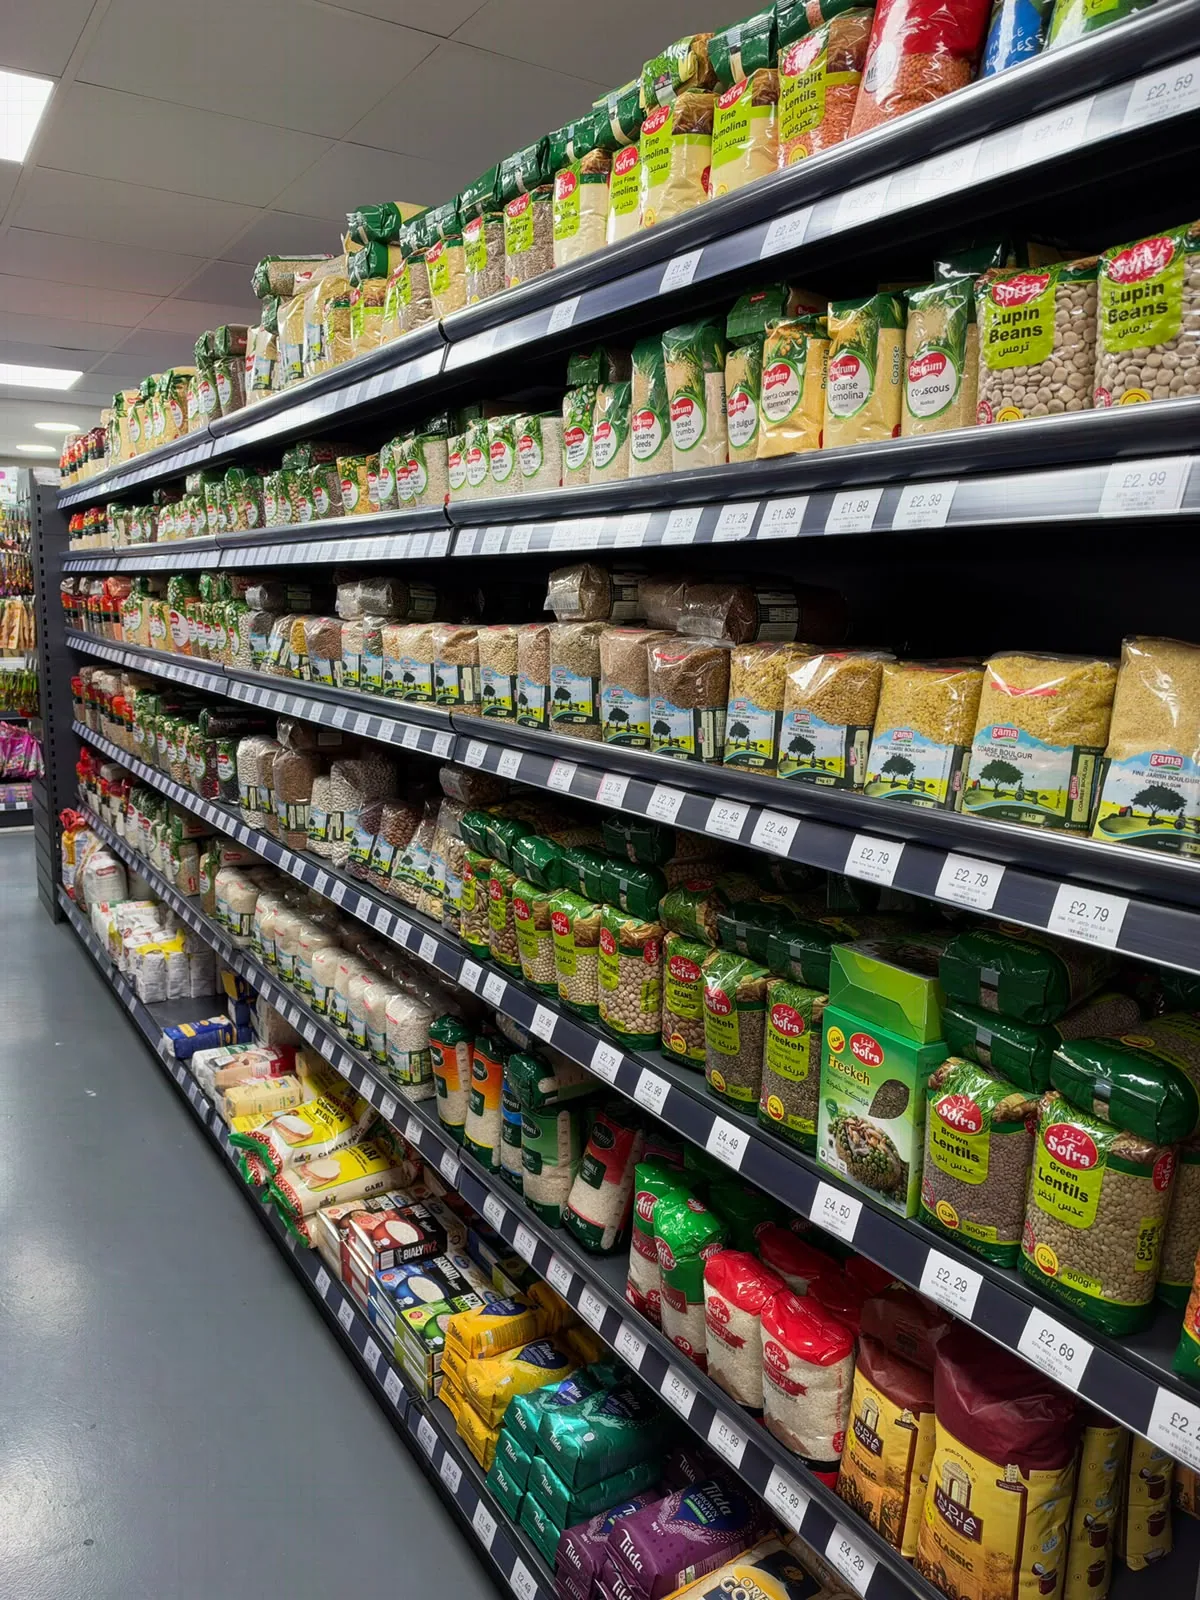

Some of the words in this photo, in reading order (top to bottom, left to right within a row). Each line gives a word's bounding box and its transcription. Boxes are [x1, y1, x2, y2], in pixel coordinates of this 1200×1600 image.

[797, 72, 822, 89] Split
[1146, 73, 1194, 101] £2.59
[719, 86, 743, 106] Sofra
[784, 89, 817, 112] Lentils
[643, 113, 666, 131] Sofra
[720, 110, 737, 124] Fine
[645, 137, 660, 148] Fine
[615, 156, 634, 170] Sofra
[624, 176, 636, 184] Fine
[996, 282, 1042, 301] Sofra
[1110, 282, 1165, 306] Lupin
[992, 306, 1040, 328] Lupin
[1108, 299, 1168, 325] Beans
[989, 324, 1043, 344] Beans
[820, 350, 830, 390] Polenta
[891, 345, 900, 385] Coarse
[778, 389, 799, 398] Coarse
[833, 381, 858, 392] Coarse
[634, 432, 655, 440] Sesame
[676, 426, 696, 436] Crumbs
[636, 440, 652, 448] Seeds
[1122, 471, 1166, 488] £2.99
[910, 493, 942, 508] £2.39
[725, 512, 748, 524] £1.29
[893, 730, 913, 739] gama
[992, 728, 1018, 738] gama
[1000, 748, 1033, 760] BOULGUR
[1150, 754, 1182, 766] gama
[1070, 776, 1079, 800] gama
[717, 808, 739, 822] £2.49
[765, 820, 788, 837] £2.49
[860, 848, 890, 864] £2.79
[954, 868, 989, 887] £2.79
[1068, 900, 1109, 922] £2.79
[670, 963, 696, 980] Sofra
[674, 990, 693, 1000] BEANS
[773, 1012, 800, 1034] Sofra
[769, 1030, 804, 1052] Freekeh
[599, 1048, 616, 1066] £2.79
[852, 1042, 880, 1064] Sofra
[828, 1054, 870, 1086] Freekeh
[644, 1078, 662, 1097] £2.99
[316, 1098, 346, 1122] CASSAVA
[938, 1102, 976, 1132] Sofra
[717, 1130, 738, 1150] £4.49
[941, 1126, 969, 1146] Brown
[932, 1131, 980, 1164] Lentils
[1047, 1136, 1090, 1167] Sofra
[950, 1161, 974, 1175] عدس
[1049, 1160, 1078, 1182] Green
[364, 1181, 384, 1192] GARI
[1038, 1166, 1090, 1204] Lentils
[824, 1197, 851, 1219] £4.50
[1057, 1202, 1084, 1218] عدس
[403, 1246, 424, 1260] BIAŁY
[1136, 1228, 1148, 1261] Green
[433, 1257, 460, 1280] BASMATI
[936, 1268, 968, 1292] £2.29
[624, 1334, 640, 1352] £2.19
[678, 1340, 690, 1351] 30
[1038, 1328, 1075, 1361] £2.69
[672, 1376, 690, 1400] £2.19
[516, 1408, 528, 1431] Tilda
[1170, 1412, 1200, 1441] £2.2
[550, 1433, 562, 1452] Tilda
[718, 1424, 740, 1448] £1.99
[854, 1426, 879, 1452] GATE
[856, 1420, 880, 1447] INDIA
[504, 1440, 518, 1463] Tilda
[679, 1454, 696, 1482] Tilda
[850, 1450, 878, 1481] CLASSIC
[496, 1469, 509, 1493] Tilda
[541, 1474, 553, 1496] Tilda
[695, 1491, 720, 1516] BROWN
[702, 1481, 732, 1516] Tilda
[778, 1482, 800, 1508] £2.99
[689, 1494, 716, 1522] BASMATI
[936, 1488, 976, 1529] INDIA
[936, 1498, 974, 1537] GATE
[534, 1511, 545, 1534] Tilda
[566, 1538, 582, 1570] Tilda
[620, 1528, 644, 1573] Tilda
[840, 1540, 865, 1571] £4.29
[934, 1532, 974, 1573] CLASSIC
